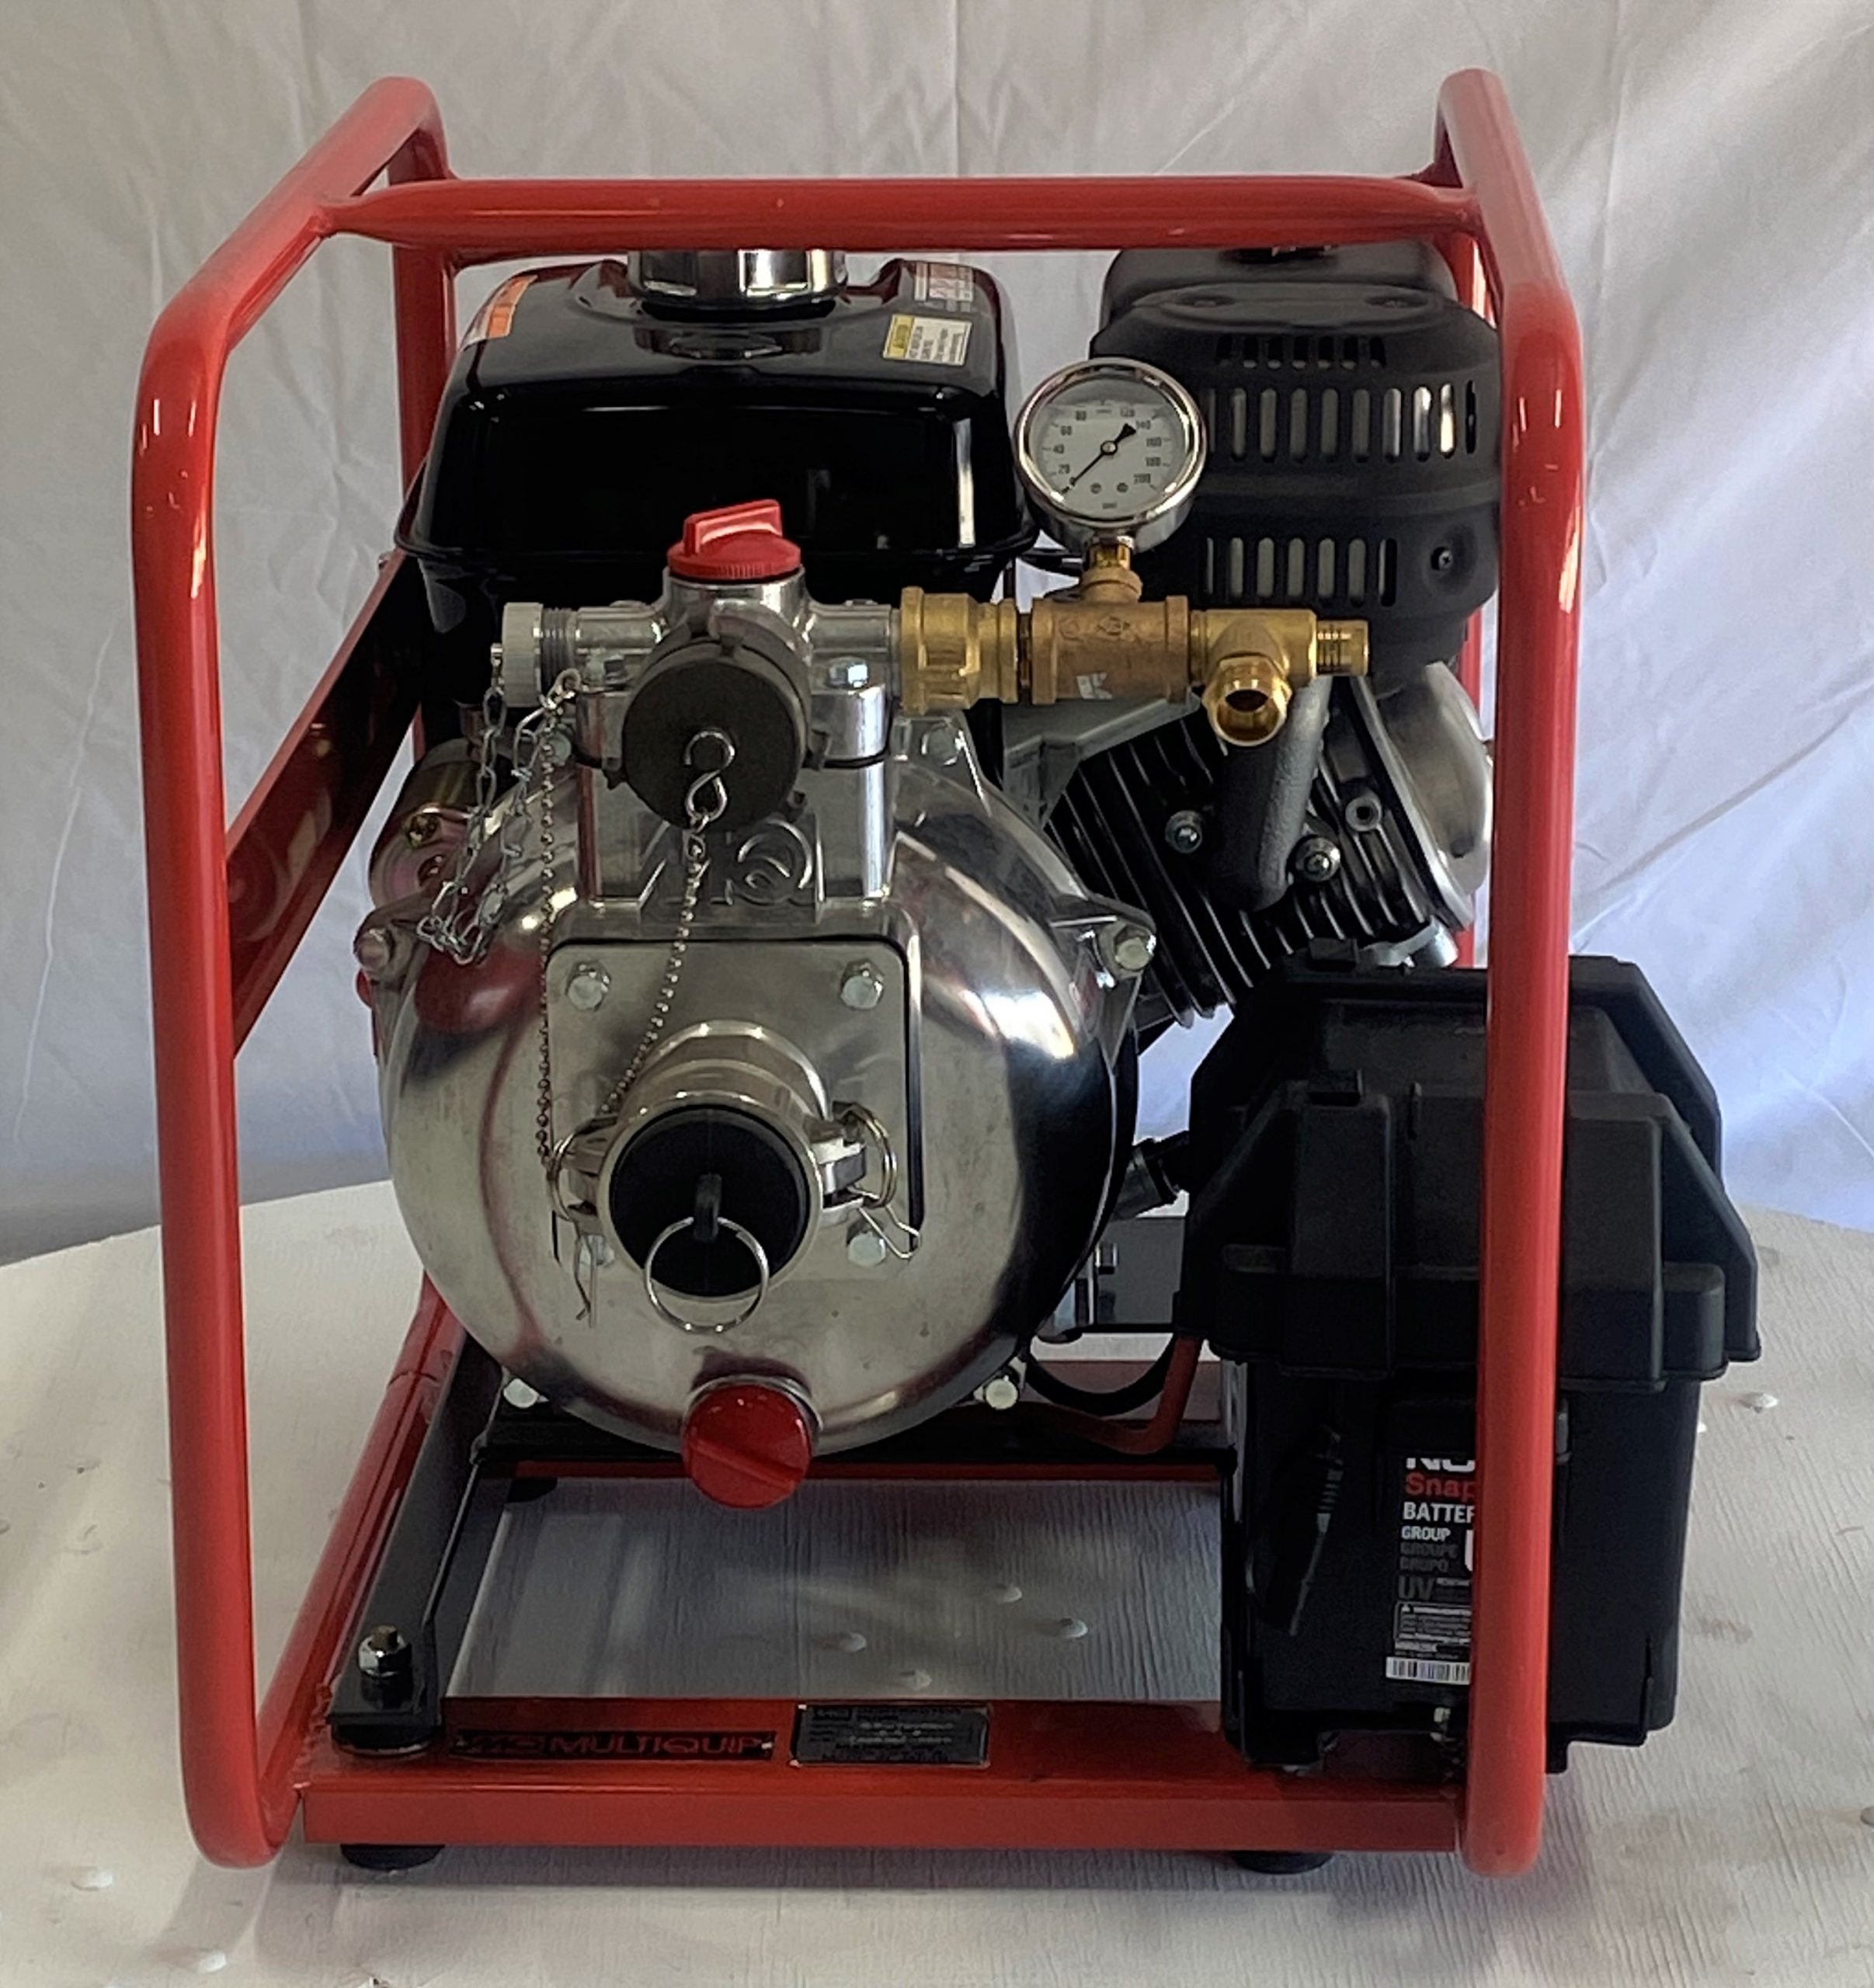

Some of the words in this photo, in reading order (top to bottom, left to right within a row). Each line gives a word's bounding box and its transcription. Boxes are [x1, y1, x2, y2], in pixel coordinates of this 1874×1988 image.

[1400, 1525, 1452, 1541] GROUP
[1398, 1576, 1435, 1600] UV
[549, 1735, 761, 1756] MULTIQUIP
